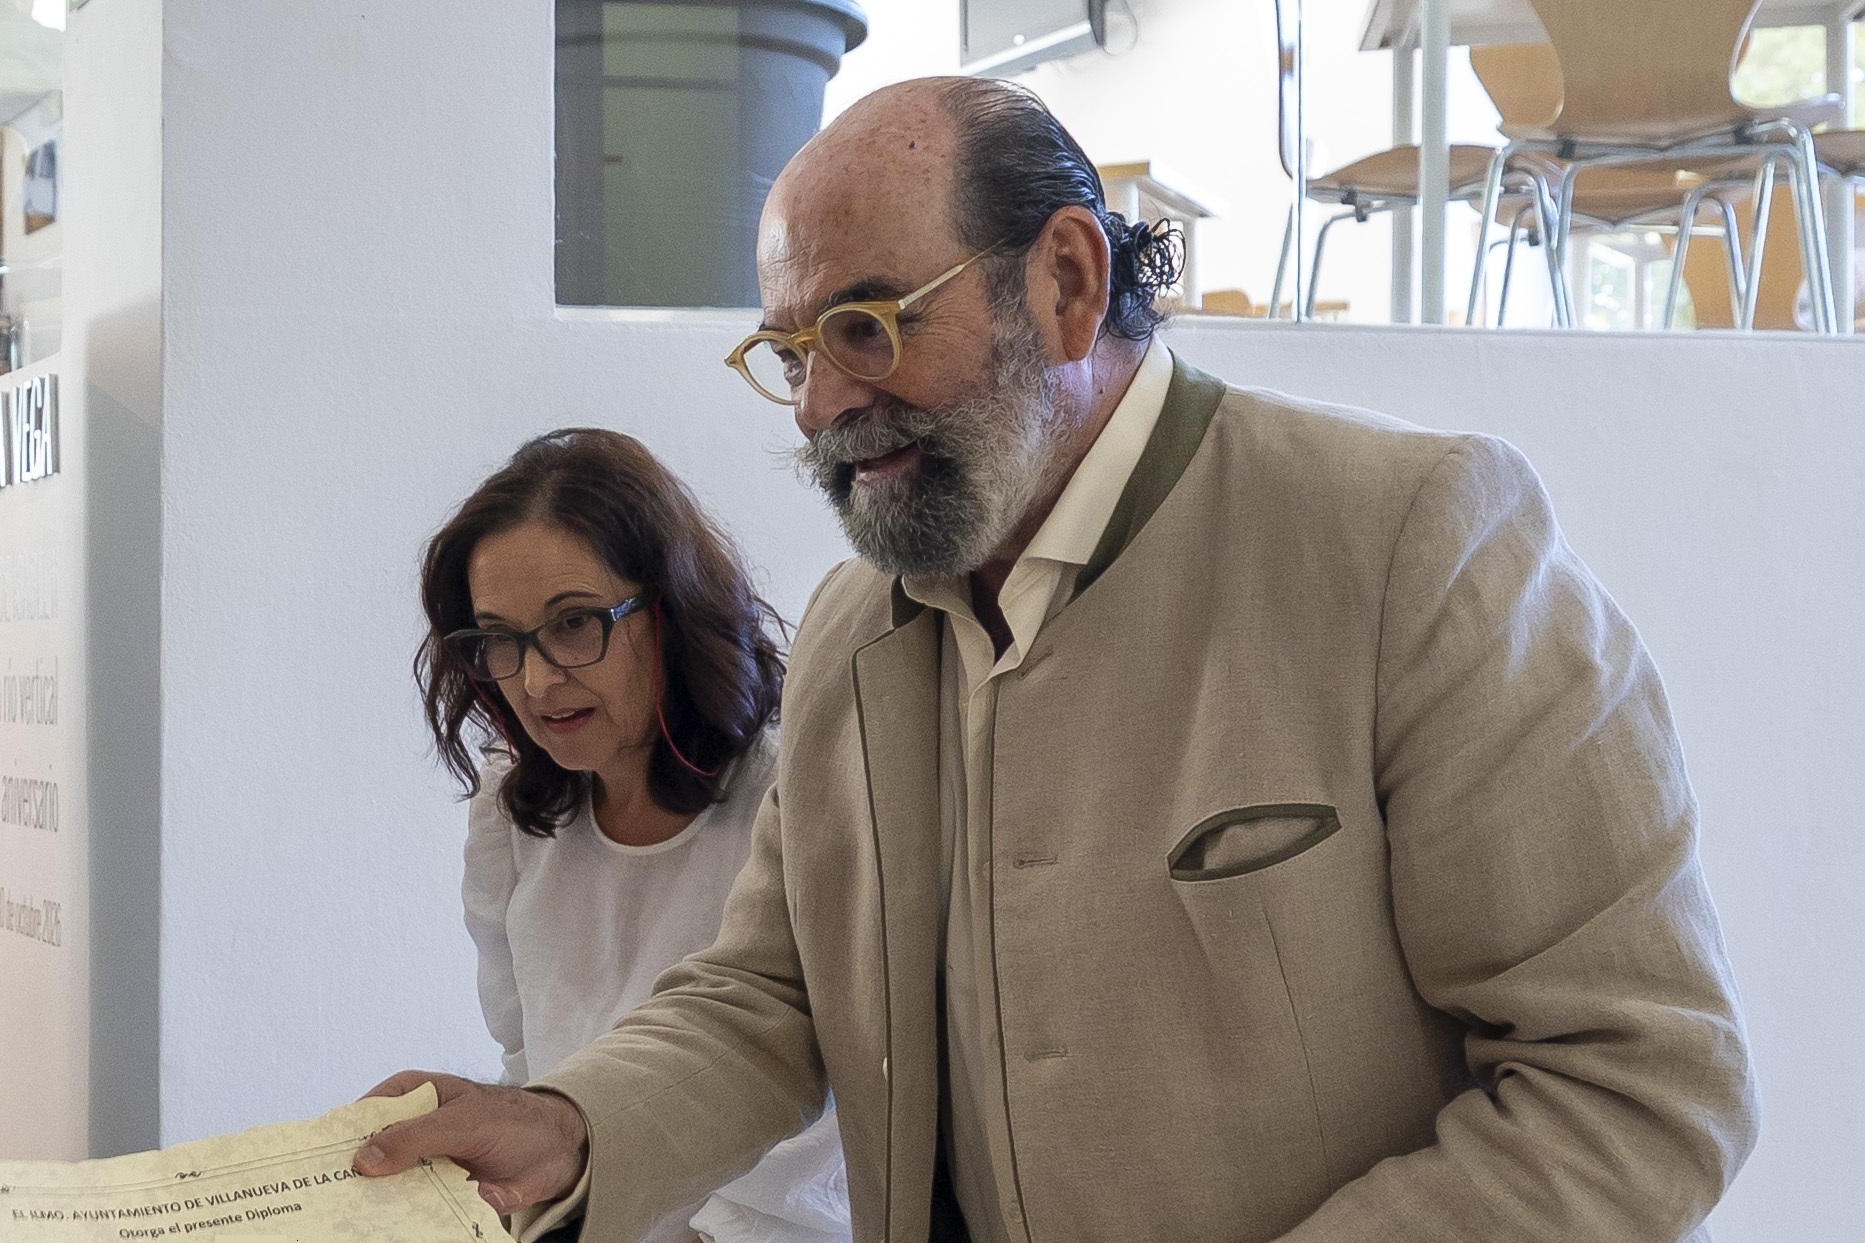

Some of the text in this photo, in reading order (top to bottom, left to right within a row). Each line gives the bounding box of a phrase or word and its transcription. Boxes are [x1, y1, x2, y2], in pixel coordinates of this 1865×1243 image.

[13, 373, 53, 484] VEGA
[19, 656, 58, 725] vertical
[1, 760, 59, 833] aniversario
[12, 1209, 26, 1220] EL
[29, 1208, 70, 1220] ILMO.
[72, 1201, 182, 1220] AYUNTAMIENTO
[185, 1197, 203, 1211] DE
[205, 1181, 291, 1206] VILLANUEVA
[292, 1176, 312, 1190] DE
[313, 1172, 332, 1186] LA
[119, 1203, 302, 1239] Otorga el presente Diploma
